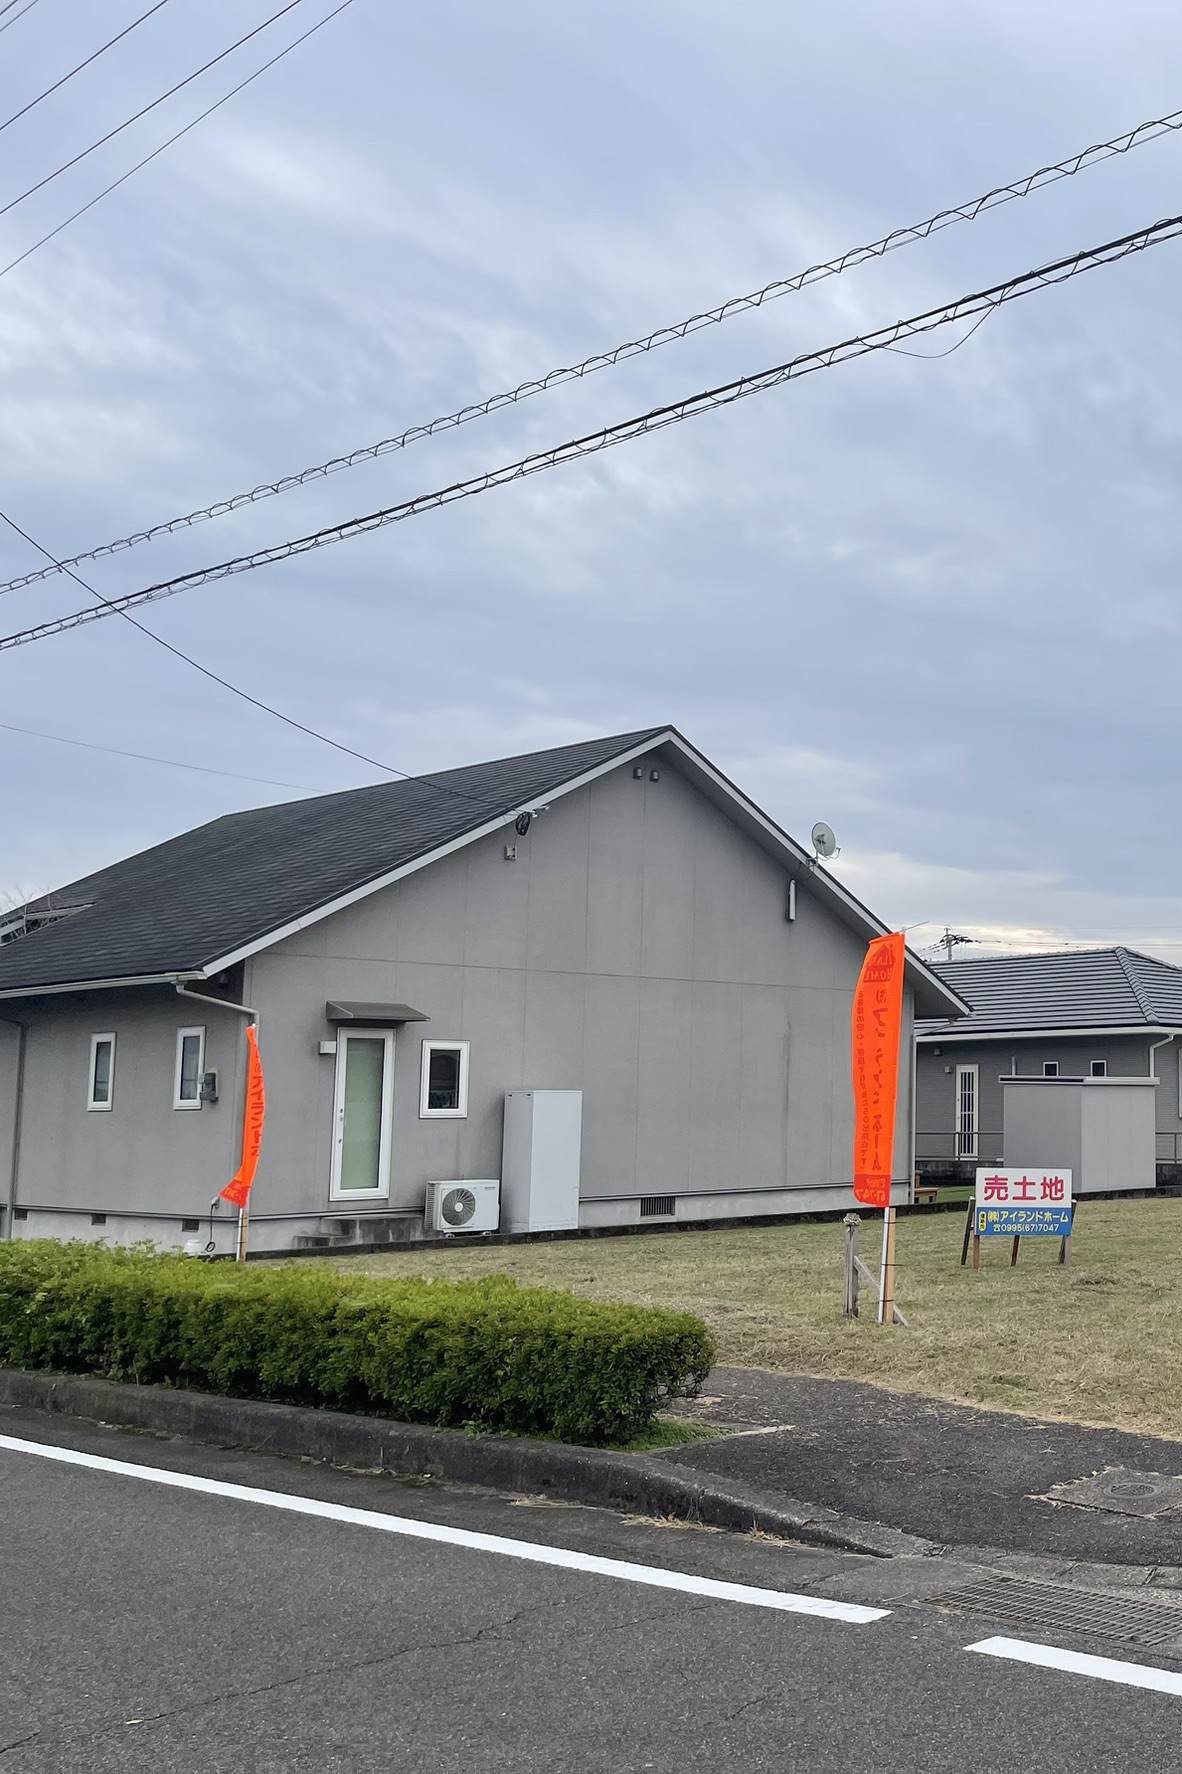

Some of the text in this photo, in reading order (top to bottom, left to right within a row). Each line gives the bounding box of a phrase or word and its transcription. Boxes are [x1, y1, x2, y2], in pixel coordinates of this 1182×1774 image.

[983, 1174, 1065, 1202] 売土地
[1001, 1223, 1060, 1232] 0995(67)7047
